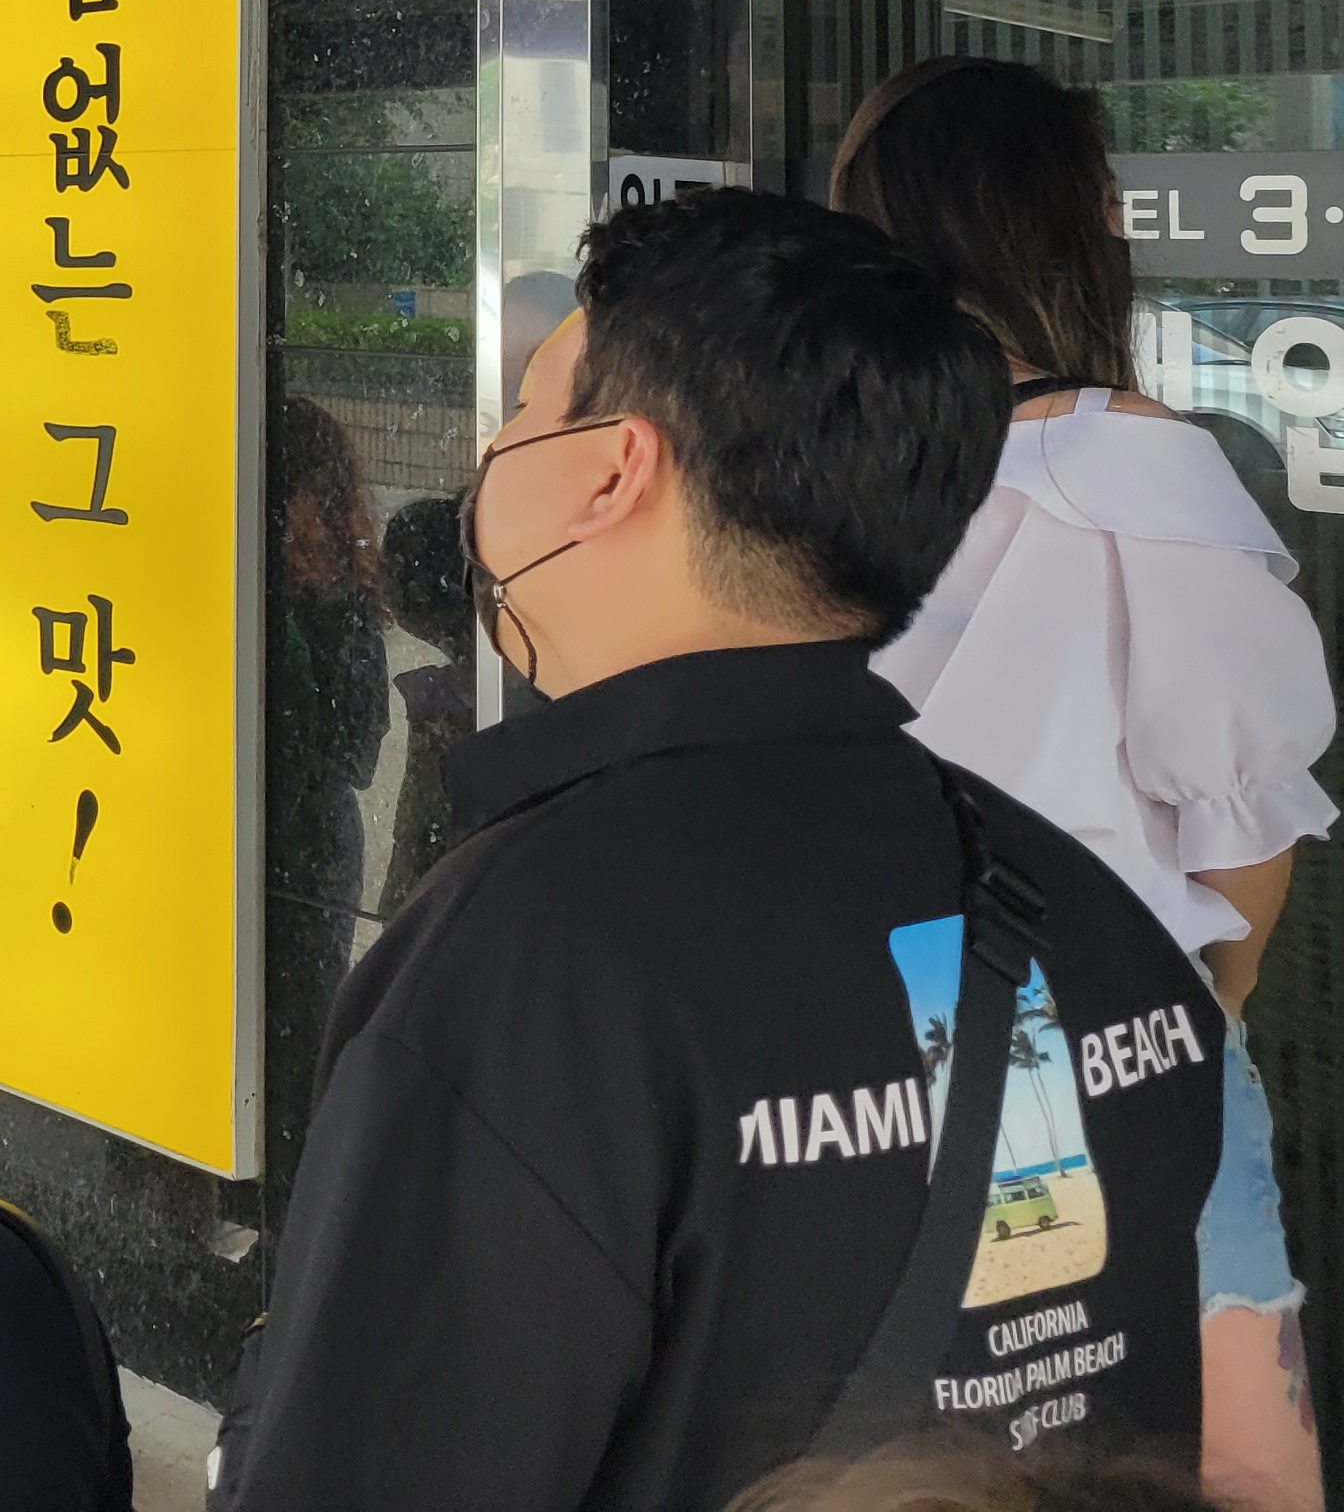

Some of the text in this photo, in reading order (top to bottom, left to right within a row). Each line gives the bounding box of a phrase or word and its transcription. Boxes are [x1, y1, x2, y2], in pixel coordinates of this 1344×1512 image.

[30, 422, 130, 527] 그
[31, 593, 137, 935] 맛!
[1080, 1003, 1205, 1097] BEACH
[934, 1331, 1126, 1410] FLORIDA PALM BEACH
[988, 1301, 1088, 1356] CALIFORNIA
[1041, 1392, 1086, 1428] CLUB
